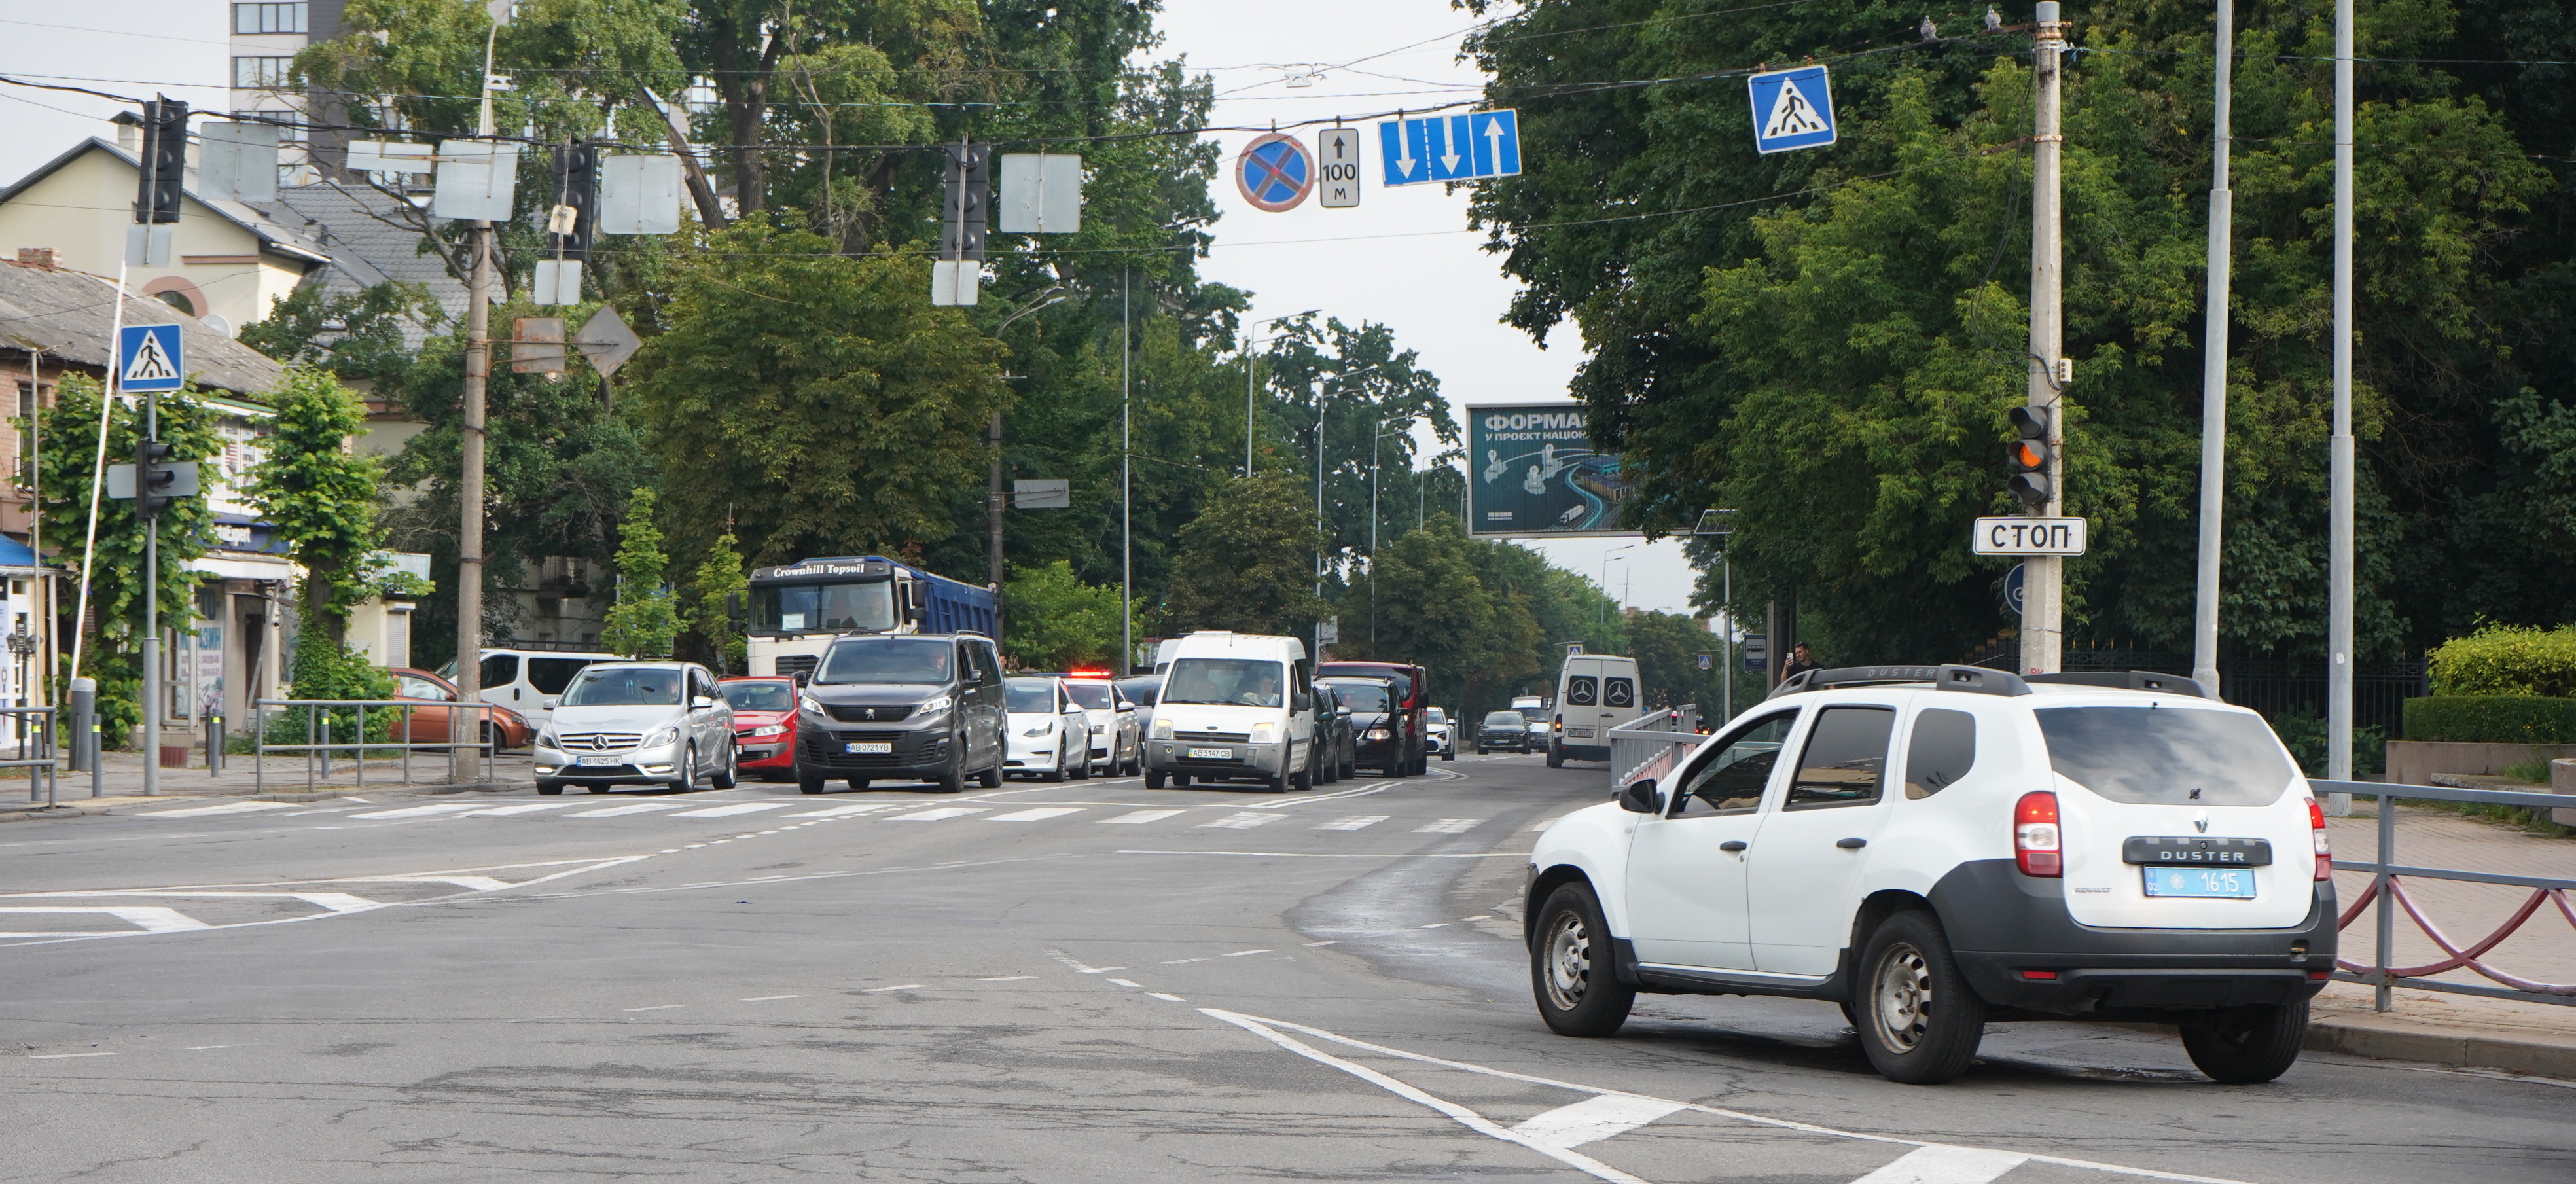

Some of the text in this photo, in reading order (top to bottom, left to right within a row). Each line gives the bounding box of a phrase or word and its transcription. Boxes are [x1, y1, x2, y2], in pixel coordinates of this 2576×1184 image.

[1323, 164, 1356, 182] 100
[1334, 188, 1346, 200] М
[1495, 432, 1541, 441] ПРОЄКТ
[1543, 430, 1591, 440] НАЦІОН
[211, 524, 251, 546] toExpert
[1991, 525, 2069, 548] СТОП
[774, 564, 865, 577] Crownhill Topsoil
[1867, 668, 1935, 677] DUSTER
[2161, 851, 2244, 861] DUSTER
[2147, 872, 2240, 893] 02 1615
